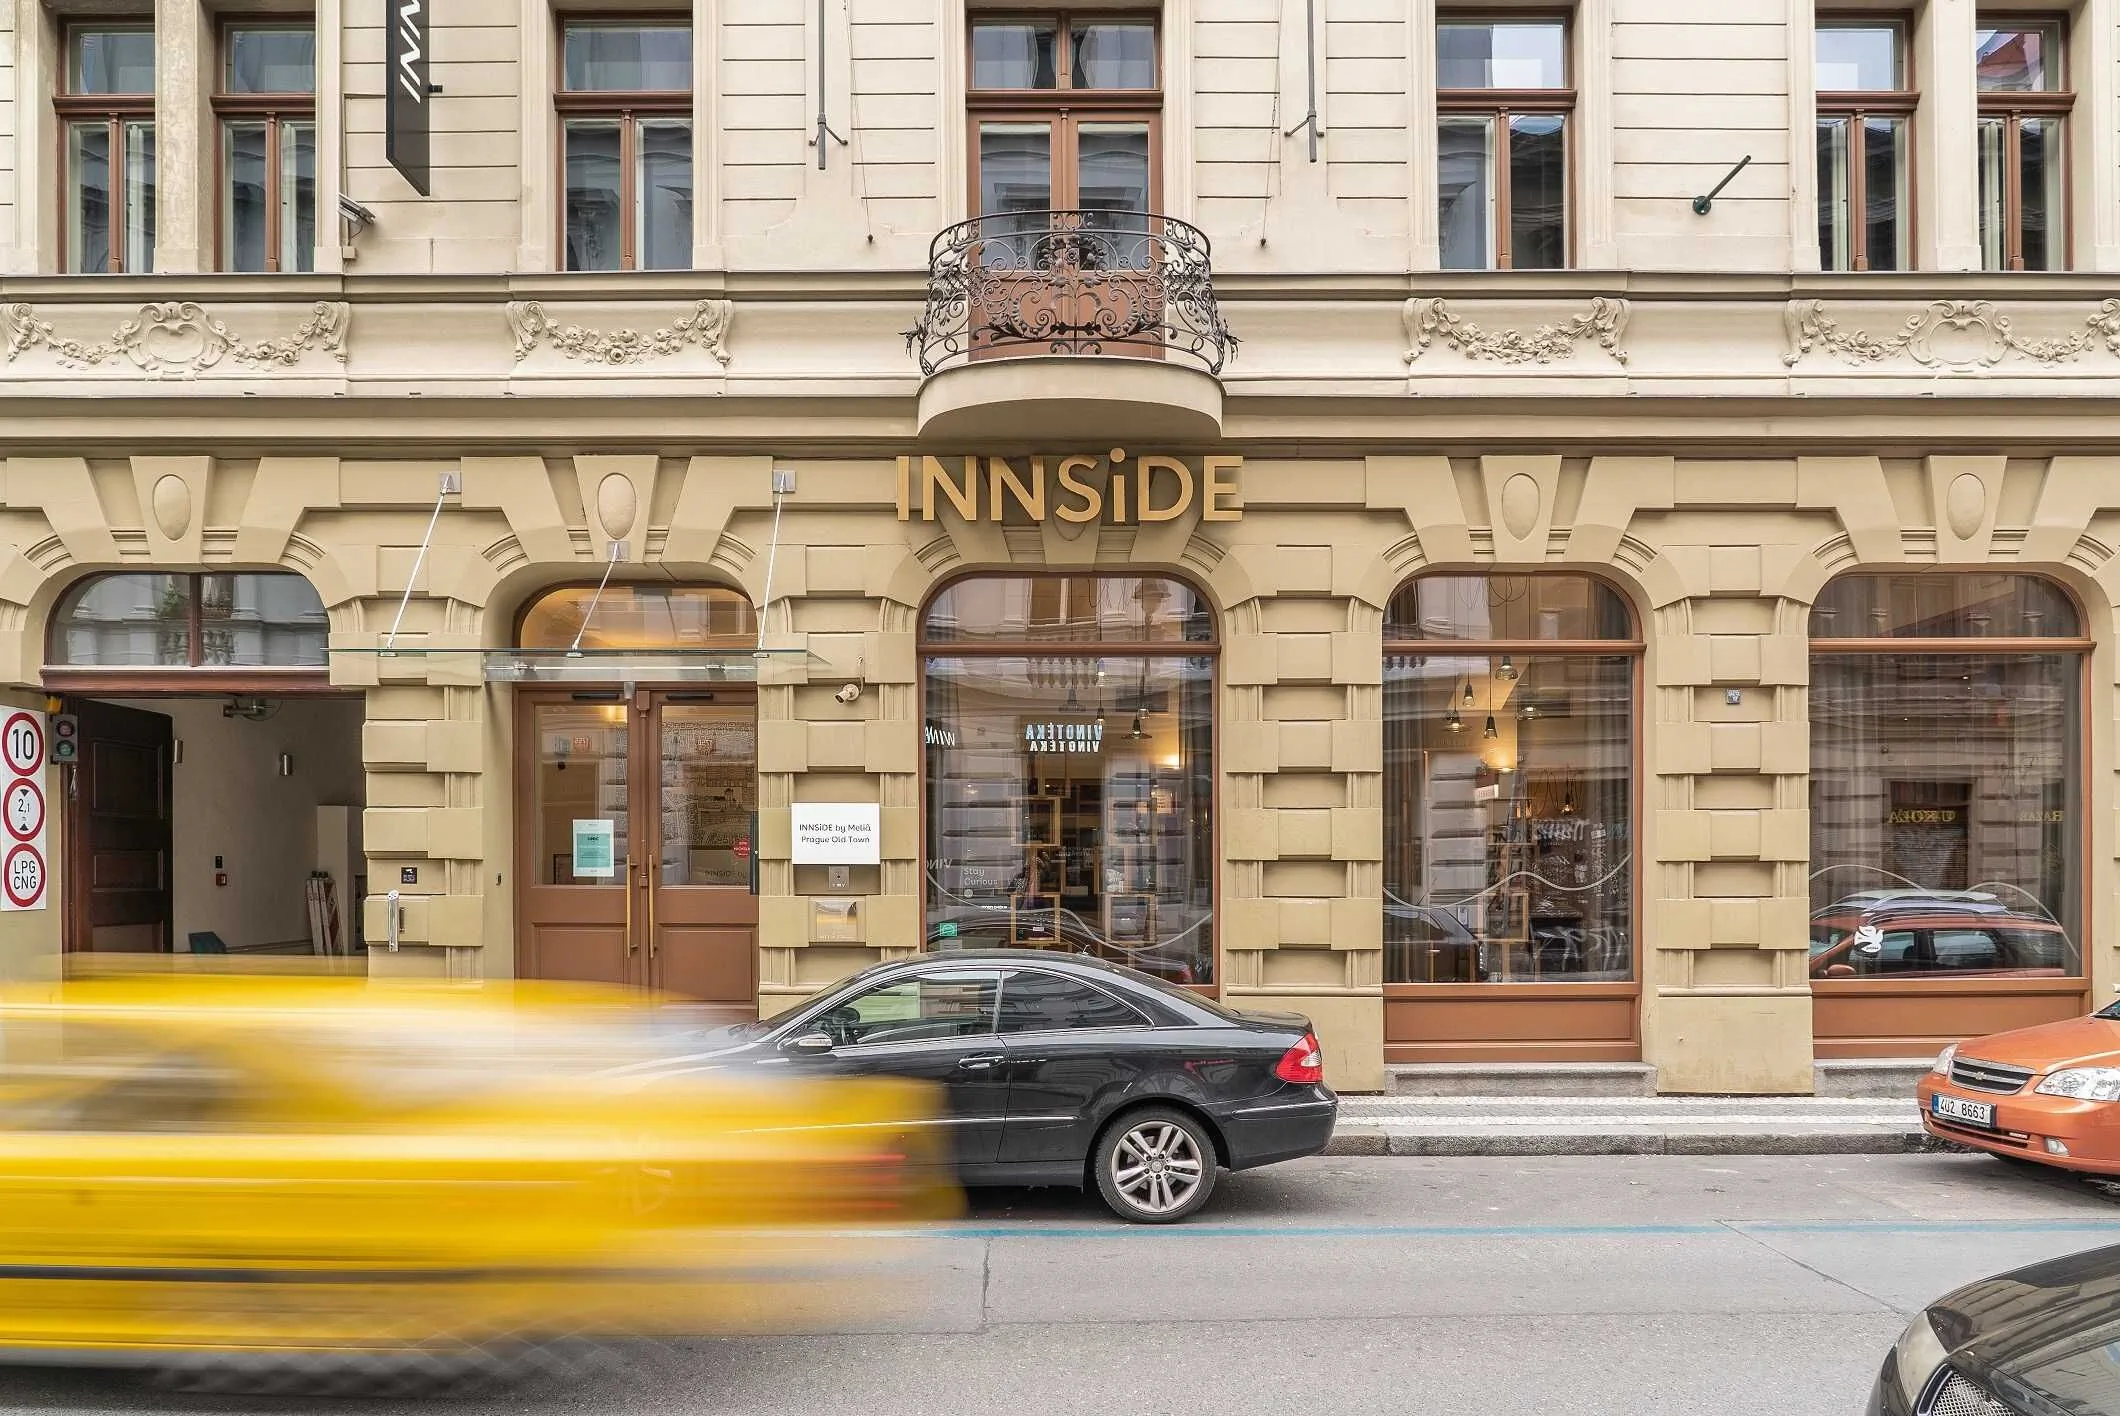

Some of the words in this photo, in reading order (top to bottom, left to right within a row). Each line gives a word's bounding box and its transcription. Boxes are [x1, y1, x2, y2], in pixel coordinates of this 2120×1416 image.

[896, 447, 1244, 523] INNSiDE
[13, 728, 35, 761] 10
[799, 823, 833, 832] INNSiDE
[835, 823, 846, 833] by
[801, 836, 830, 845] Prague
[14, 860, 36, 874] LPG
[963, 867, 985, 877] Stay
[13, 875, 37, 890] CNG
[964, 878, 998, 886] Curious
[1940, 1097, 1956, 1114] 4U2
[1961, 1103, 1985, 1120] 8663
